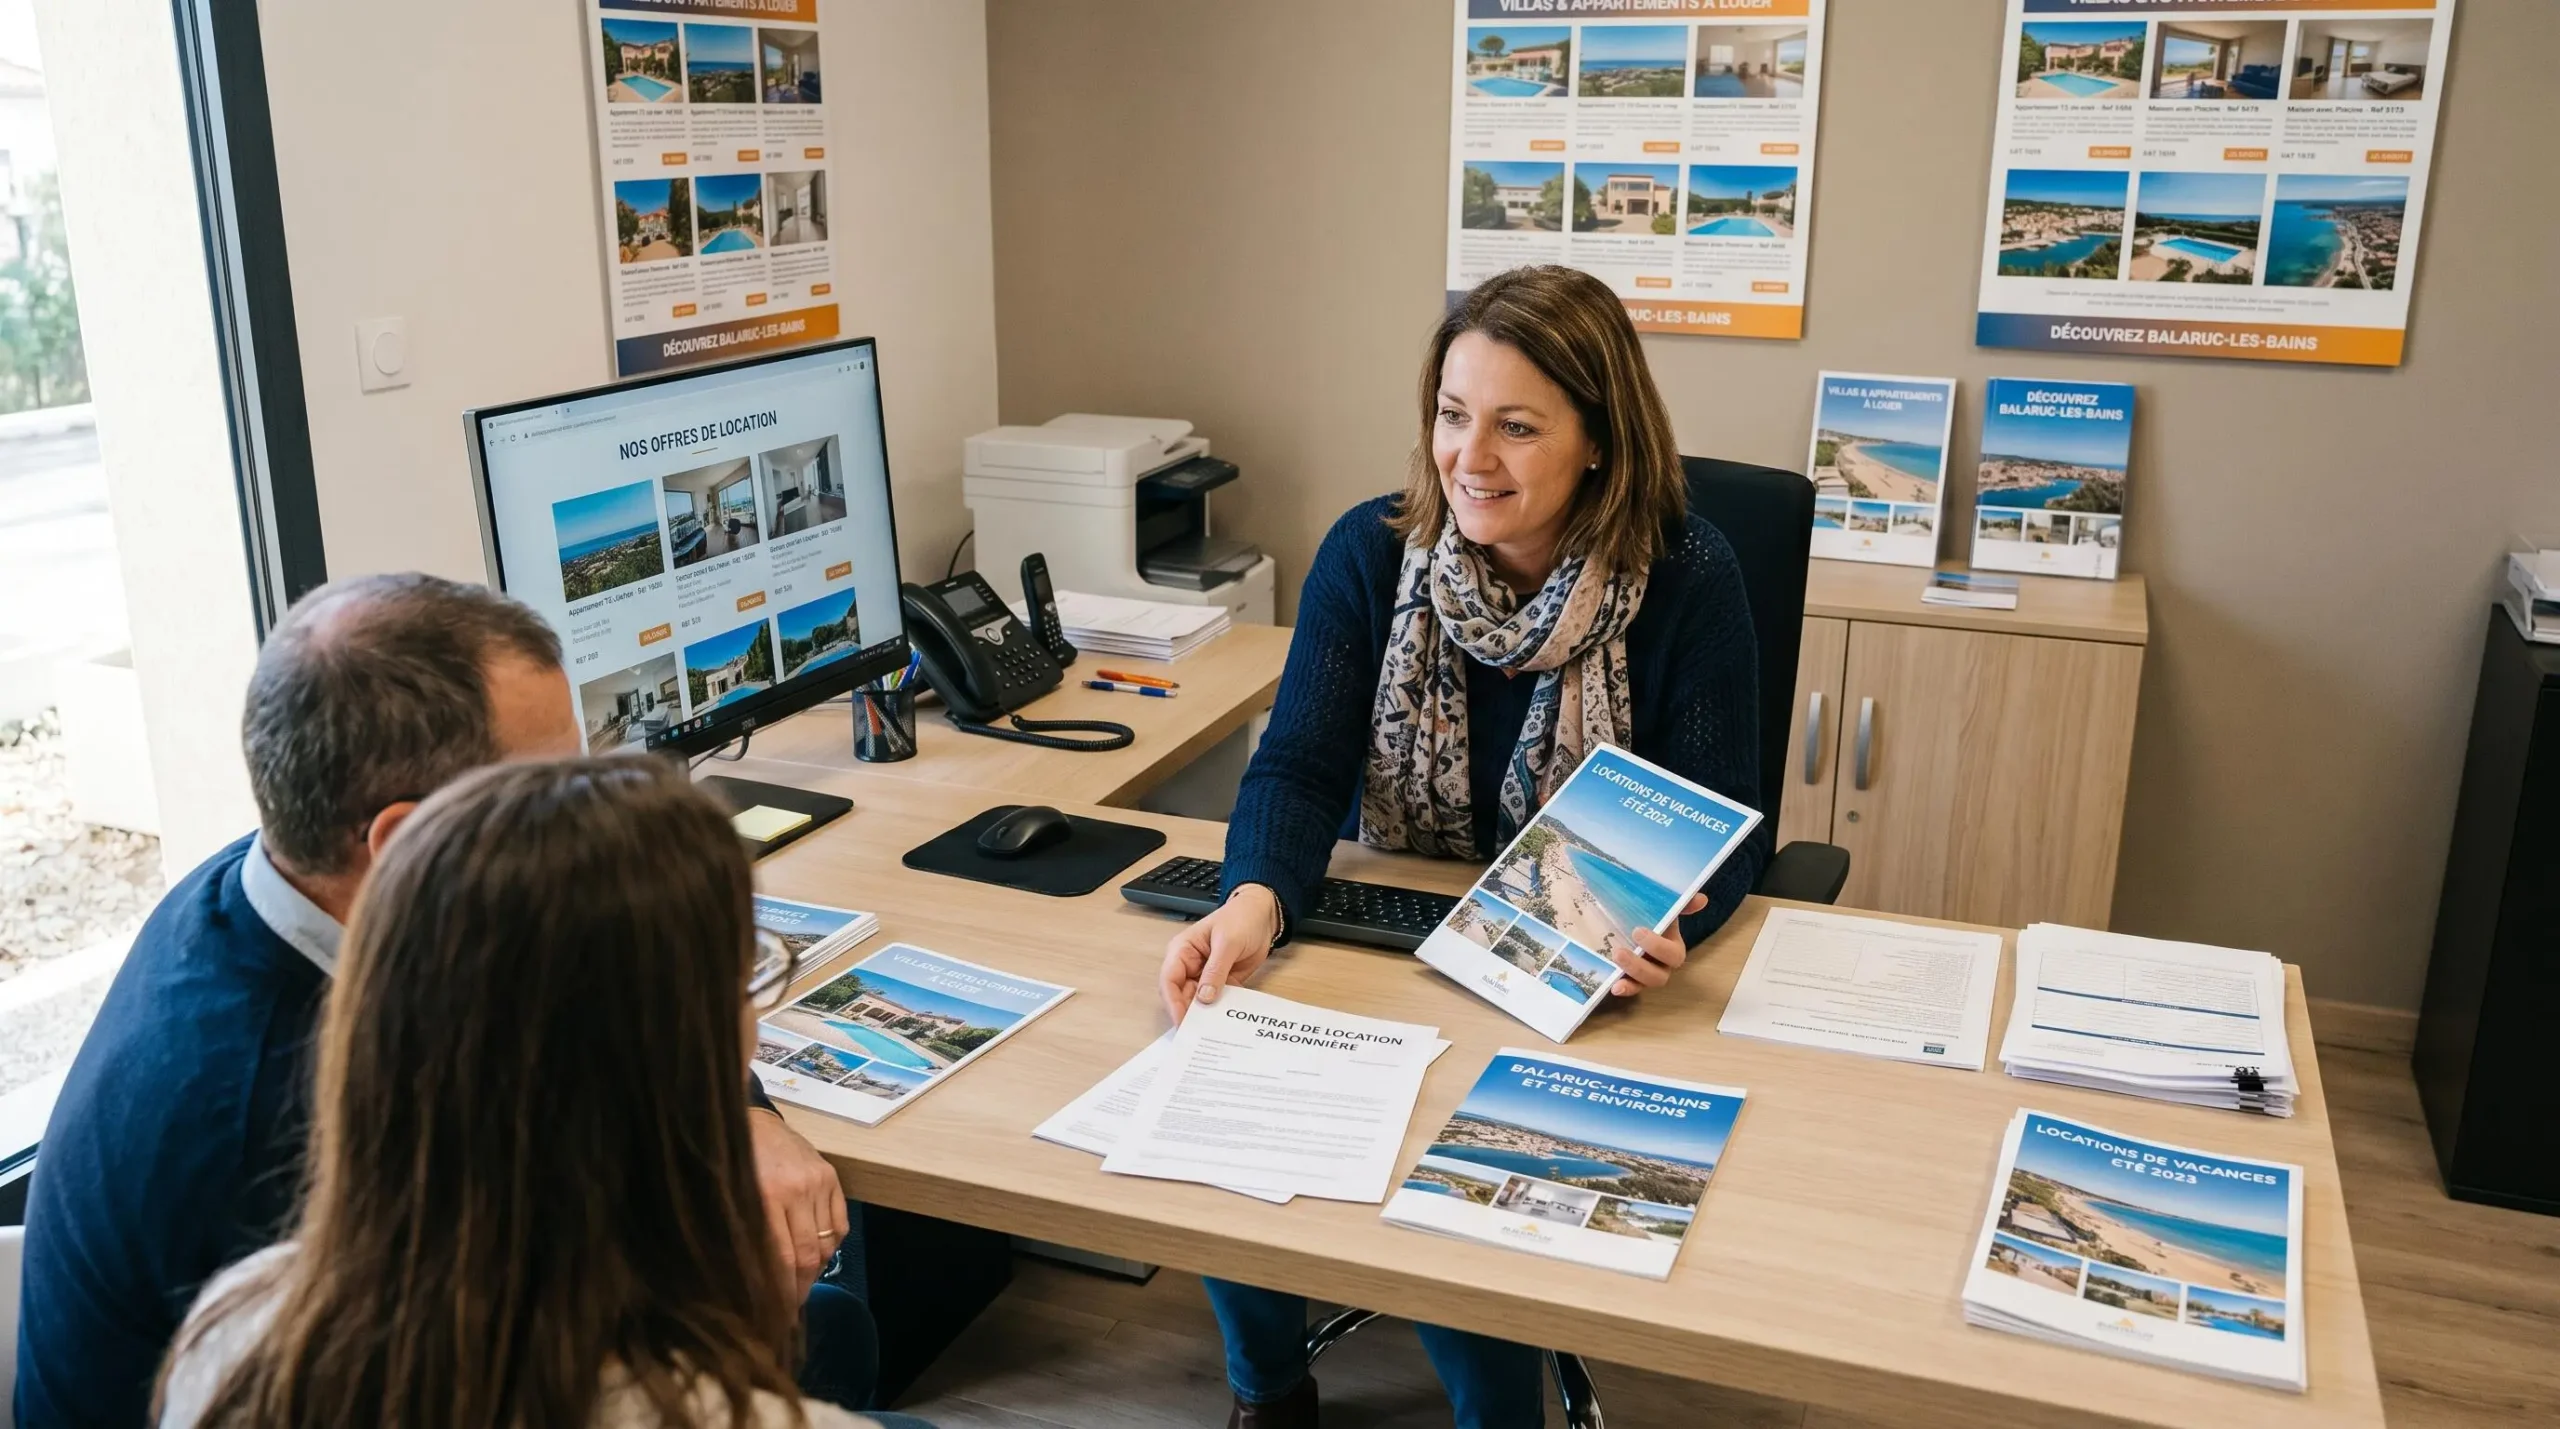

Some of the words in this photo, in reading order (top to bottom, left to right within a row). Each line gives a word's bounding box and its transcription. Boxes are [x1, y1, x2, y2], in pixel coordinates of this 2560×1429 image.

[1500, 0, 1554, 11] VILLAS
[1570, 0, 1699, 11] APPARTEMENTS
[1627, 307, 1731, 326] UC-LES-BAINS
[663, 334, 718, 357] DÉCOUVREZ
[2050, 322, 2144, 343] DÉCOUVREZ
[2147, 329, 2318, 351] BALARUC-LES-BAINS
[1999, 403, 2124, 421] BALARUC-LES-BAINS
[2027, 389, 2099, 406] DÉCOUVREZ
[619, 439, 648, 460] NOS
[651, 428, 699, 452] OFFRES
[701, 424, 718, 442] DE
[719, 410, 777, 437] LOCATION
[1591, 763, 1654, 799] LOCATIONS
[1650, 792, 1671, 807] DE
[1670, 799, 1730, 835] VACANCES
[1623, 796, 1649, 814] ÉTÉ
[1643, 807, 1674, 828] 2024
[1226, 1009, 1297, 1030] CONTRAT
[1299, 1024, 1321, 1034] DE
[1325, 1028, 1402, 1046] LOCATION
[1255, 1028, 1359, 1051] SAISONNIÈRE
[1510, 1064, 1711, 1110] BALARUC-LES-BAINS
[1521, 1077, 1547, 1089] ET
[1549, 1084, 1584, 1098] SES
[1587, 1092, 1687, 1118] ENVIRONS
[2036, 1124, 2138, 1159] LOCATIONS
[2143, 1152, 2168, 1166] DE
[2173, 1159, 2277, 1185] VACANCES
[2151, 1166, 2197, 1185] 2023
